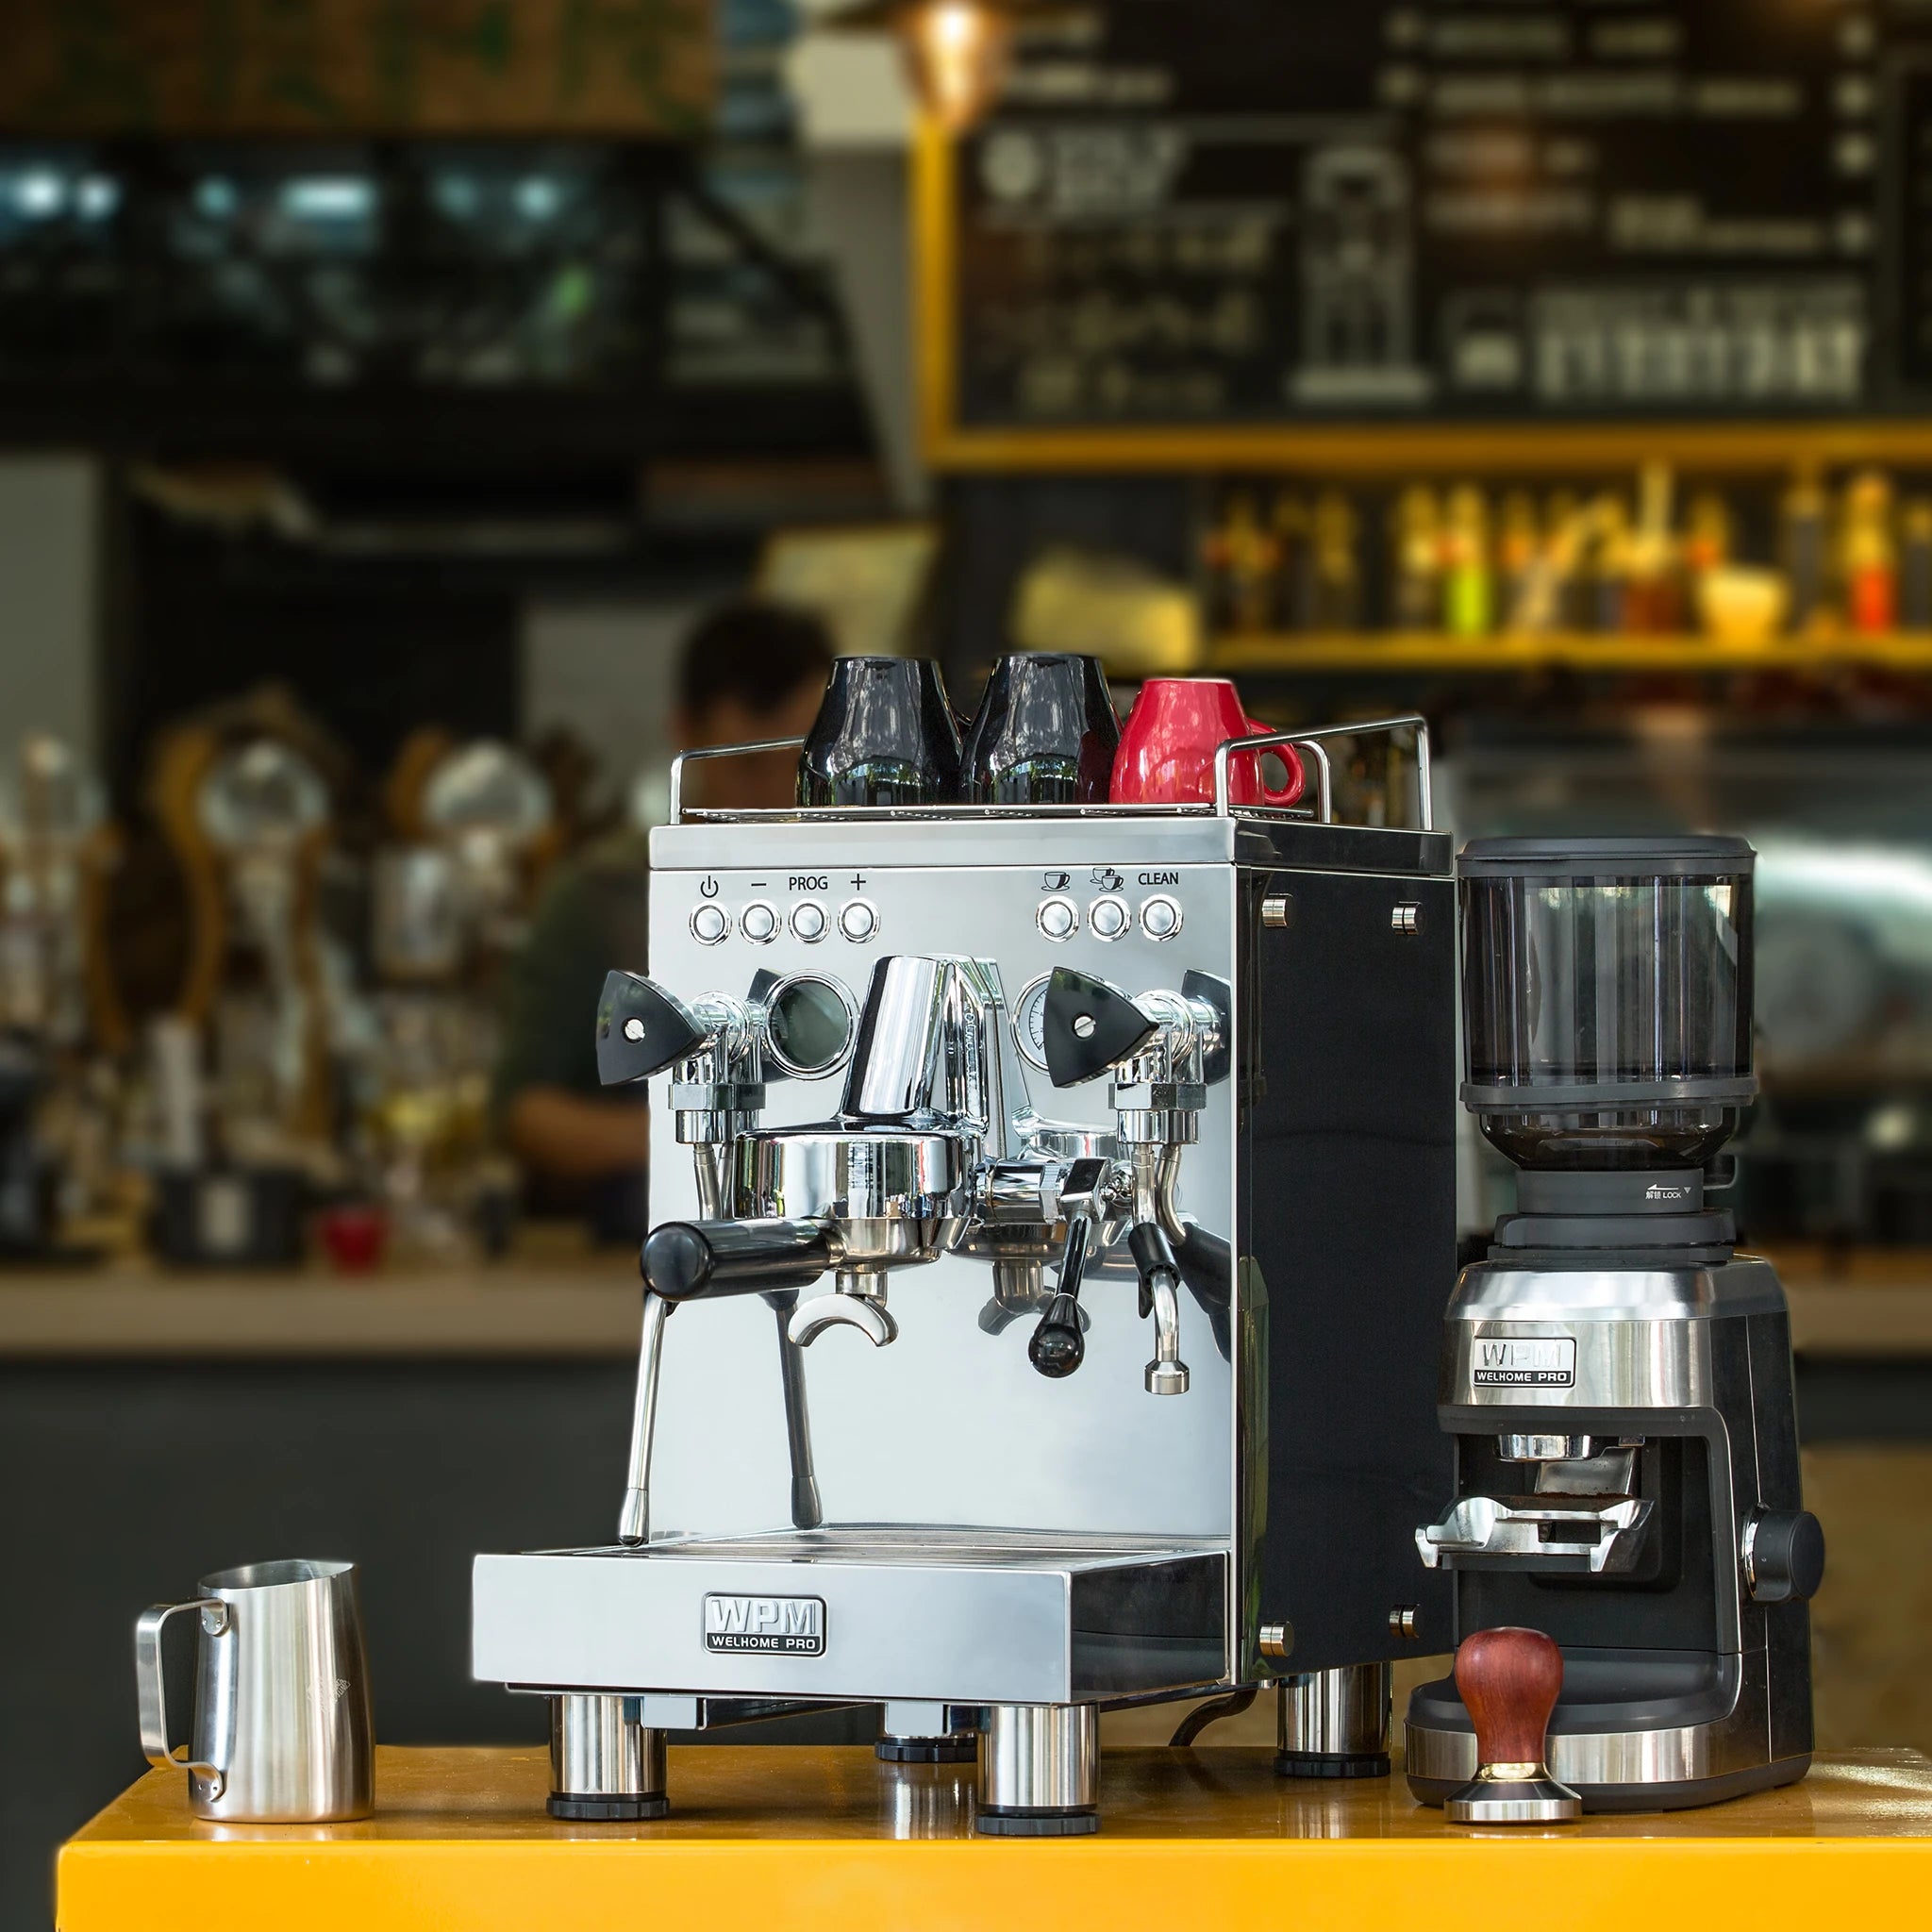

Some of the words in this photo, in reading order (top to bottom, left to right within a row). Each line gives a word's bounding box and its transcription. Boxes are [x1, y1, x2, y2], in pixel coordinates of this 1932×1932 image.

[789, 875, 828, 891] PROG
[1138, 872, 1179, 885] CLEAN
[1482, 1342, 1561, 1368] WPM
[1476, 1372, 1532, 1382] WELHOME
[1538, 1372, 1567, 1382] PRO
[711, 1599, 816, 1635] WPM
[711, 1636, 779, 1649] WELHOME
[786, 1638, 816, 1650] PRO
